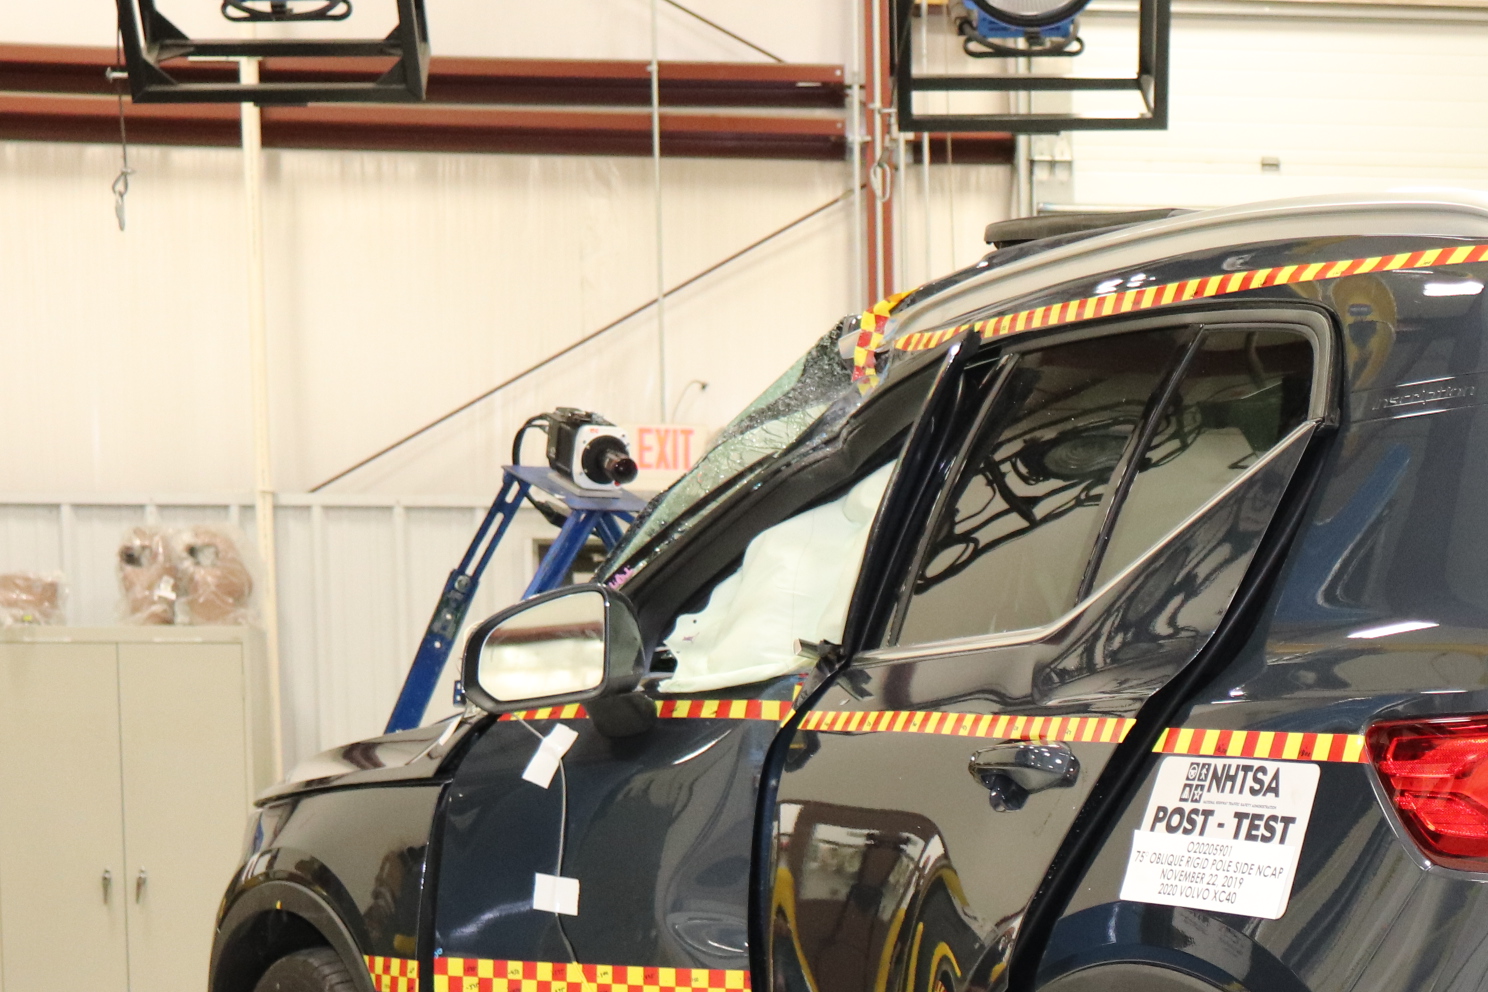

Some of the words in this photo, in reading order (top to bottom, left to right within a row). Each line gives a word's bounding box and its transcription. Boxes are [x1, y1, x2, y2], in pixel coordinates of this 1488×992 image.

[637, 427, 695, 471] EXIT
[1206, 763, 1281, 798] NHTSA
[1150, 805, 1215, 837] POST
[1233, 811, 1297, 845] TEST
[1149, 852, 1184, 867] OBLIQUE
[1185, 856, 1209, 870] RIGID
[1210, 859, 1232, 873] POLE
[1233, 861, 1254, 876] SIDE
[1255, 864, 1284, 879] NCAP
[1160, 868, 1205, 885] NOVEMBER
[1222, 876, 1244, 890] 2019
[1157, 883, 1178, 896] 2020
[1179, 886, 1210, 900] VOLVO
[1211, 890, 1237, 905] XC40
